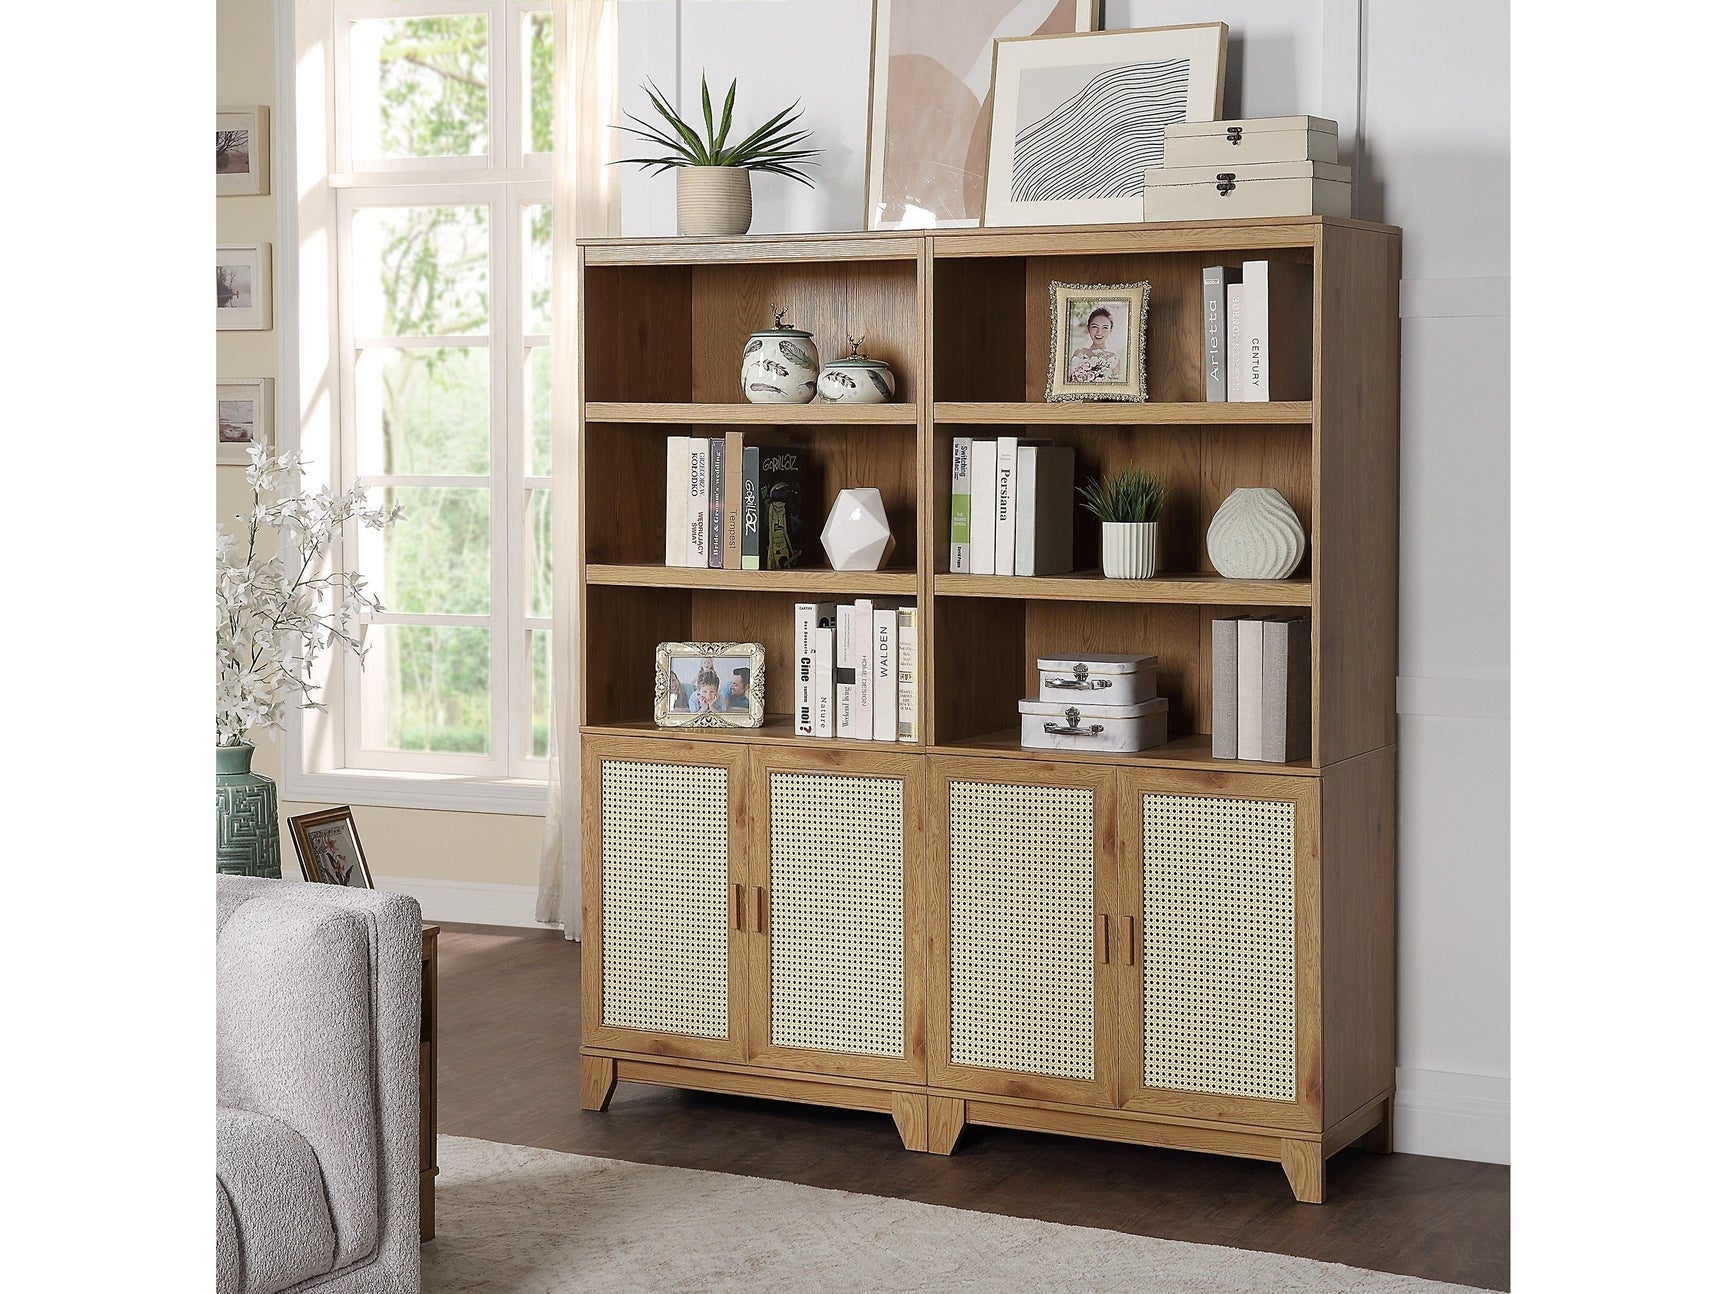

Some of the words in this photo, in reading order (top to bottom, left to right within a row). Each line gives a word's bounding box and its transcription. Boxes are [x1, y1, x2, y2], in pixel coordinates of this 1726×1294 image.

[1209, 300, 1219, 381] Arletta
[1251, 338, 1260, 386] CENTURY
[959, 445, 968, 478] Switching
[1000, 469, 1011, 521] Persiana
[713, 524, 719, 532] &
[729, 509, 738, 549] Tempest
[801, 657, 811, 682] Cine
[880, 626, 888, 678] WALDEN
[842, 686, 852, 702] living
[842, 703, 850, 728] Weekend
